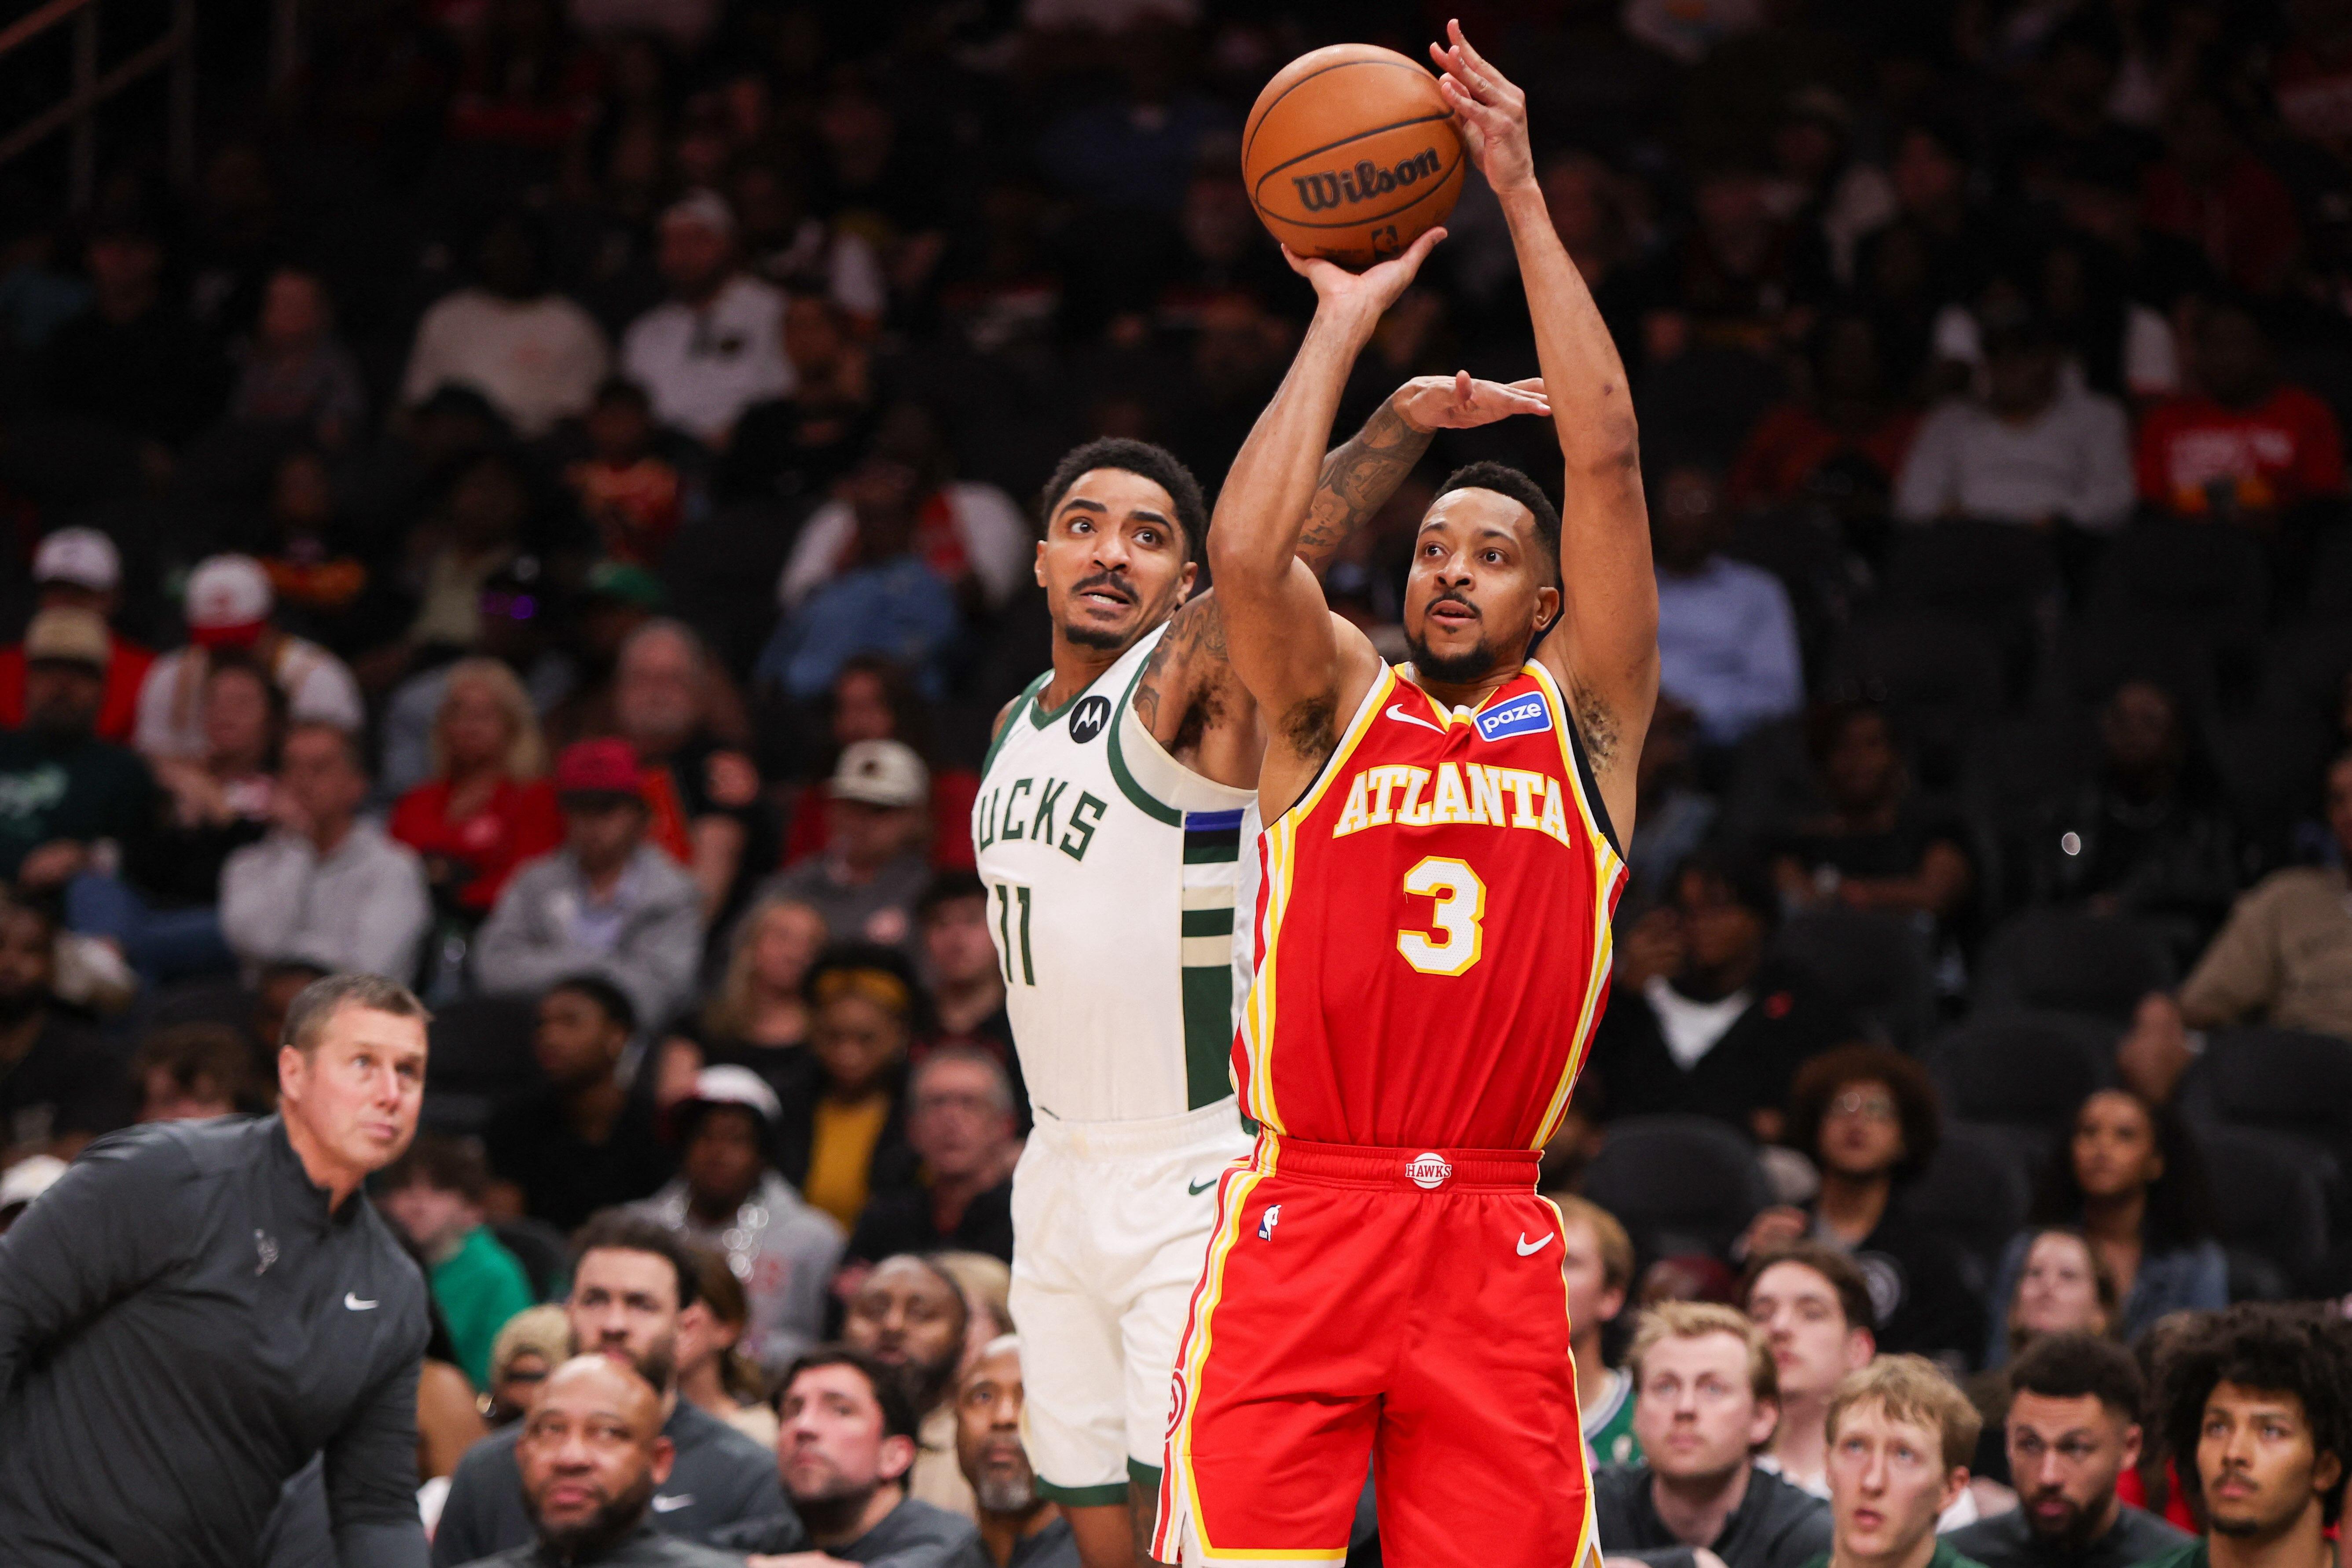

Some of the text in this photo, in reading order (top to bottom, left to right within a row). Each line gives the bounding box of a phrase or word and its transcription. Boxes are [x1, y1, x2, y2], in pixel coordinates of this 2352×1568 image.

[1292, 147, 1441, 212] Wilson
[1482, 703, 1542, 734] paze
[980, 777, 1108, 862] UCKS
[1332, 762, 1570, 849] ATLANTA
[996, 885, 1035, 985] 11
[1397, 856, 1487, 977] 3
[1406, 1164, 1451, 1177] HAWKS
[1259, 1230, 1268, 1239] NBA
